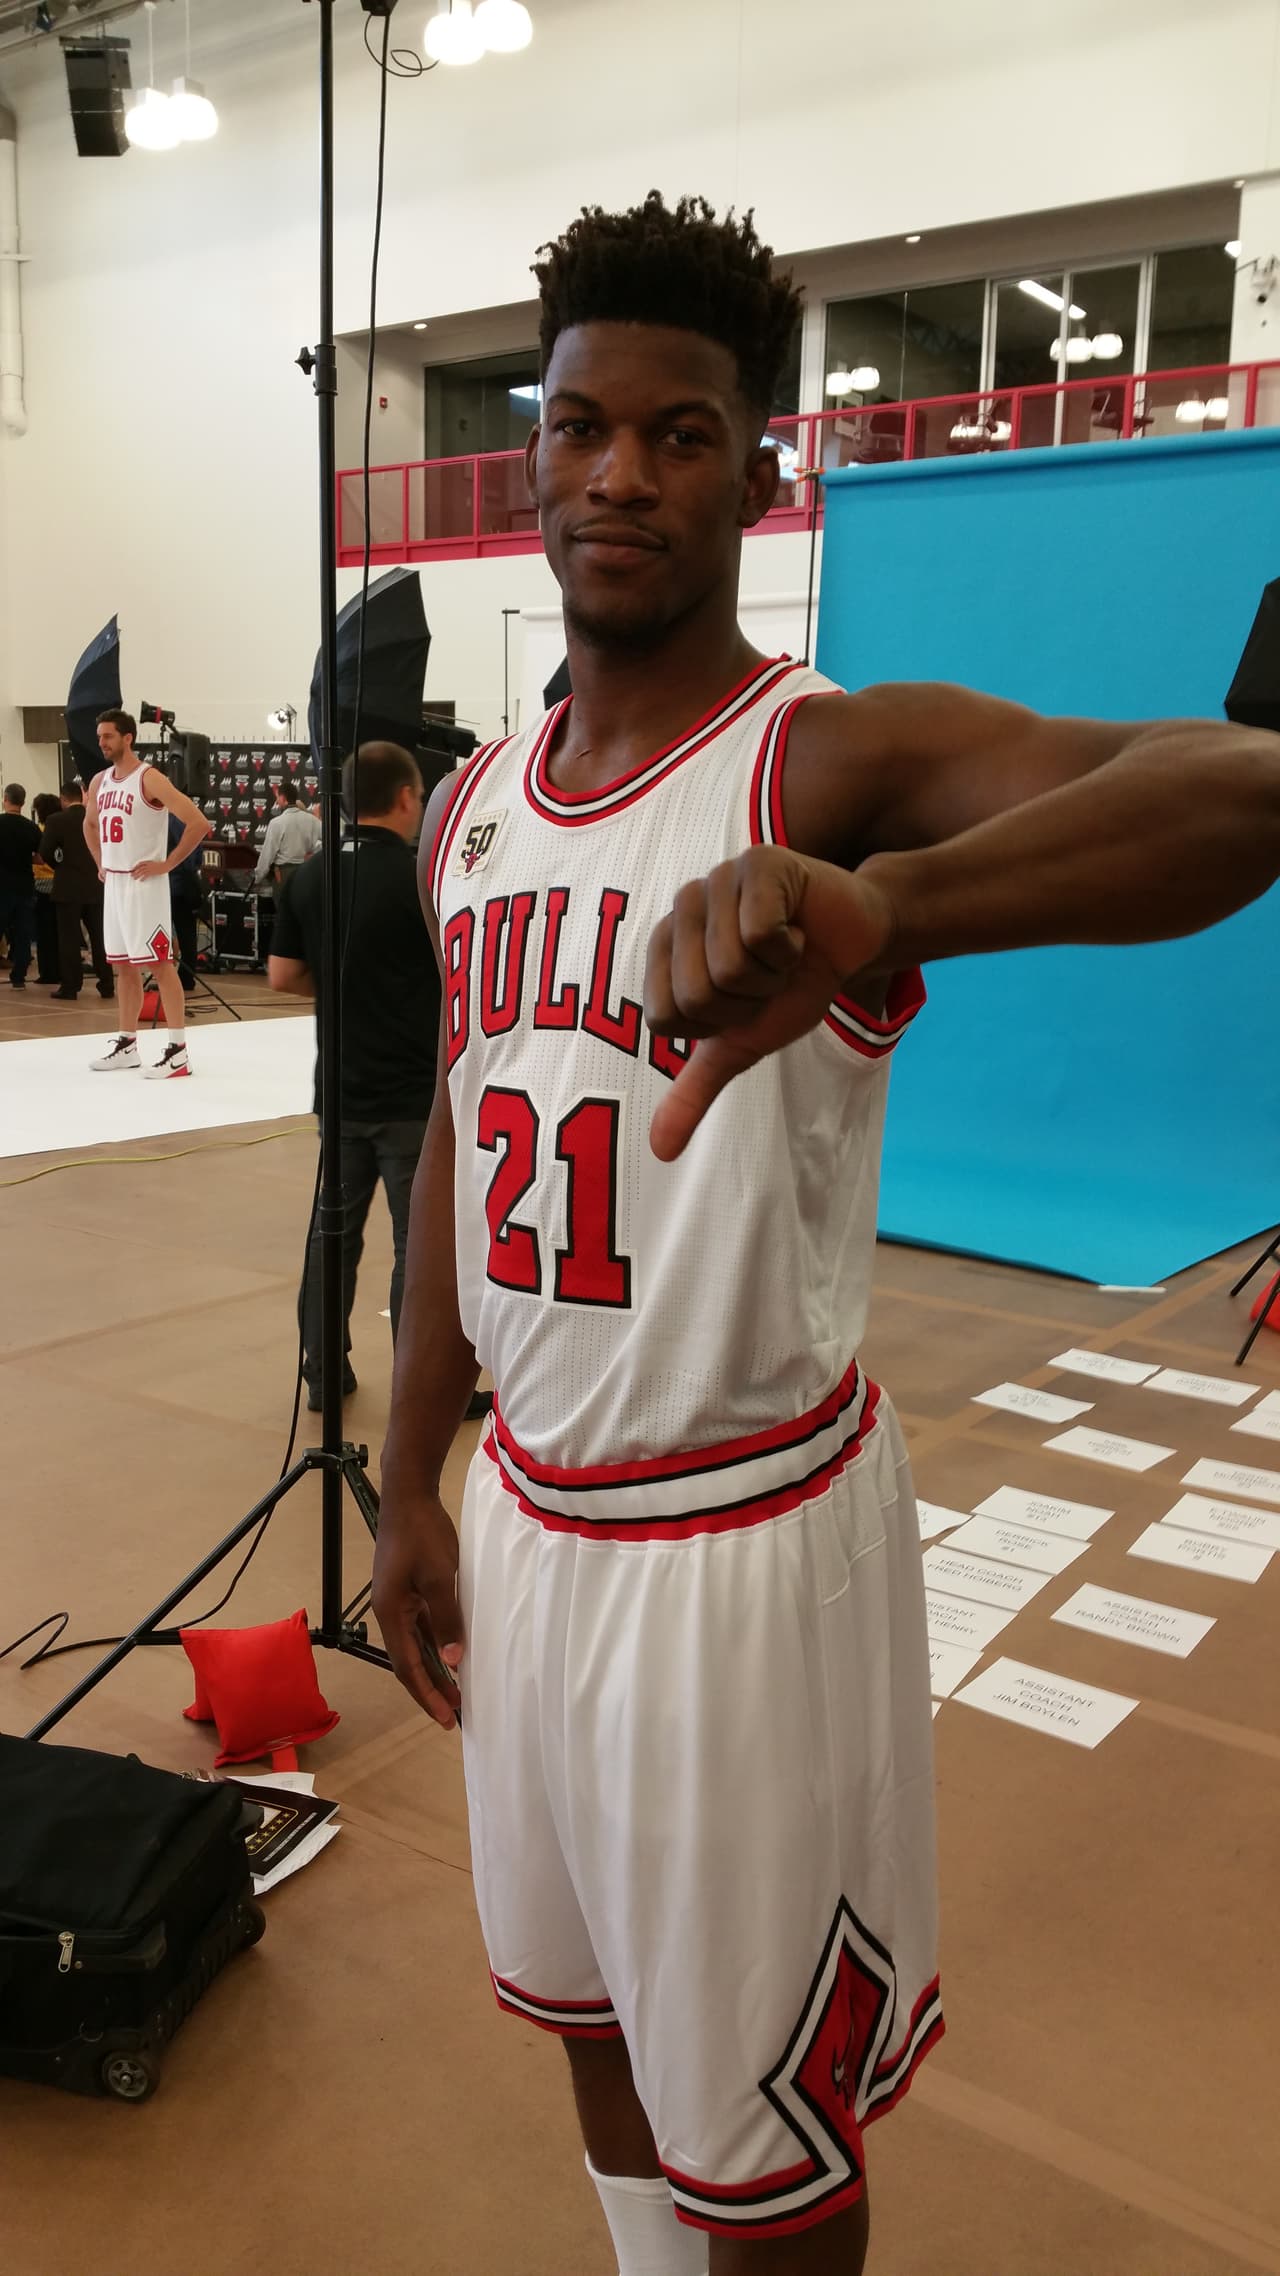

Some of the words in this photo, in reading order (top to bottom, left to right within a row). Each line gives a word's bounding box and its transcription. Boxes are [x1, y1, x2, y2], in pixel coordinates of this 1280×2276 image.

[98, 790, 134, 816] BULLS
[102, 815, 123, 843] 16
[461, 822, 497, 858] 50
[445, 886, 698, 1081] BULL
[476, 1083, 632, 1309] 21
[927, 1563, 963, 1579] FRED
[963, 1573, 1023, 1593] HOIBERG
[939, 1559, 975, 1572] HEAD
[977, 1568, 1024, 1585] COACH
[926, 1600, 977, 1618] SISTANT
[1102, 1599, 1178, 1625] ASSISTANT
[1108, 1609, 1160, 1629] COACH
[934, 1619, 978, 1635] HENRY
[1075, 1608, 1122, 1627] RANDY
[1126, 1622, 1183, 1644] BROWN
[1014, 1677, 1096, 1708] ASSISTANT
[1018, 1689, 1074, 1713] COACH
[991, 1693, 1019, 1706] JIM
[1018, 1701, 1081, 1727] BOYLEN
